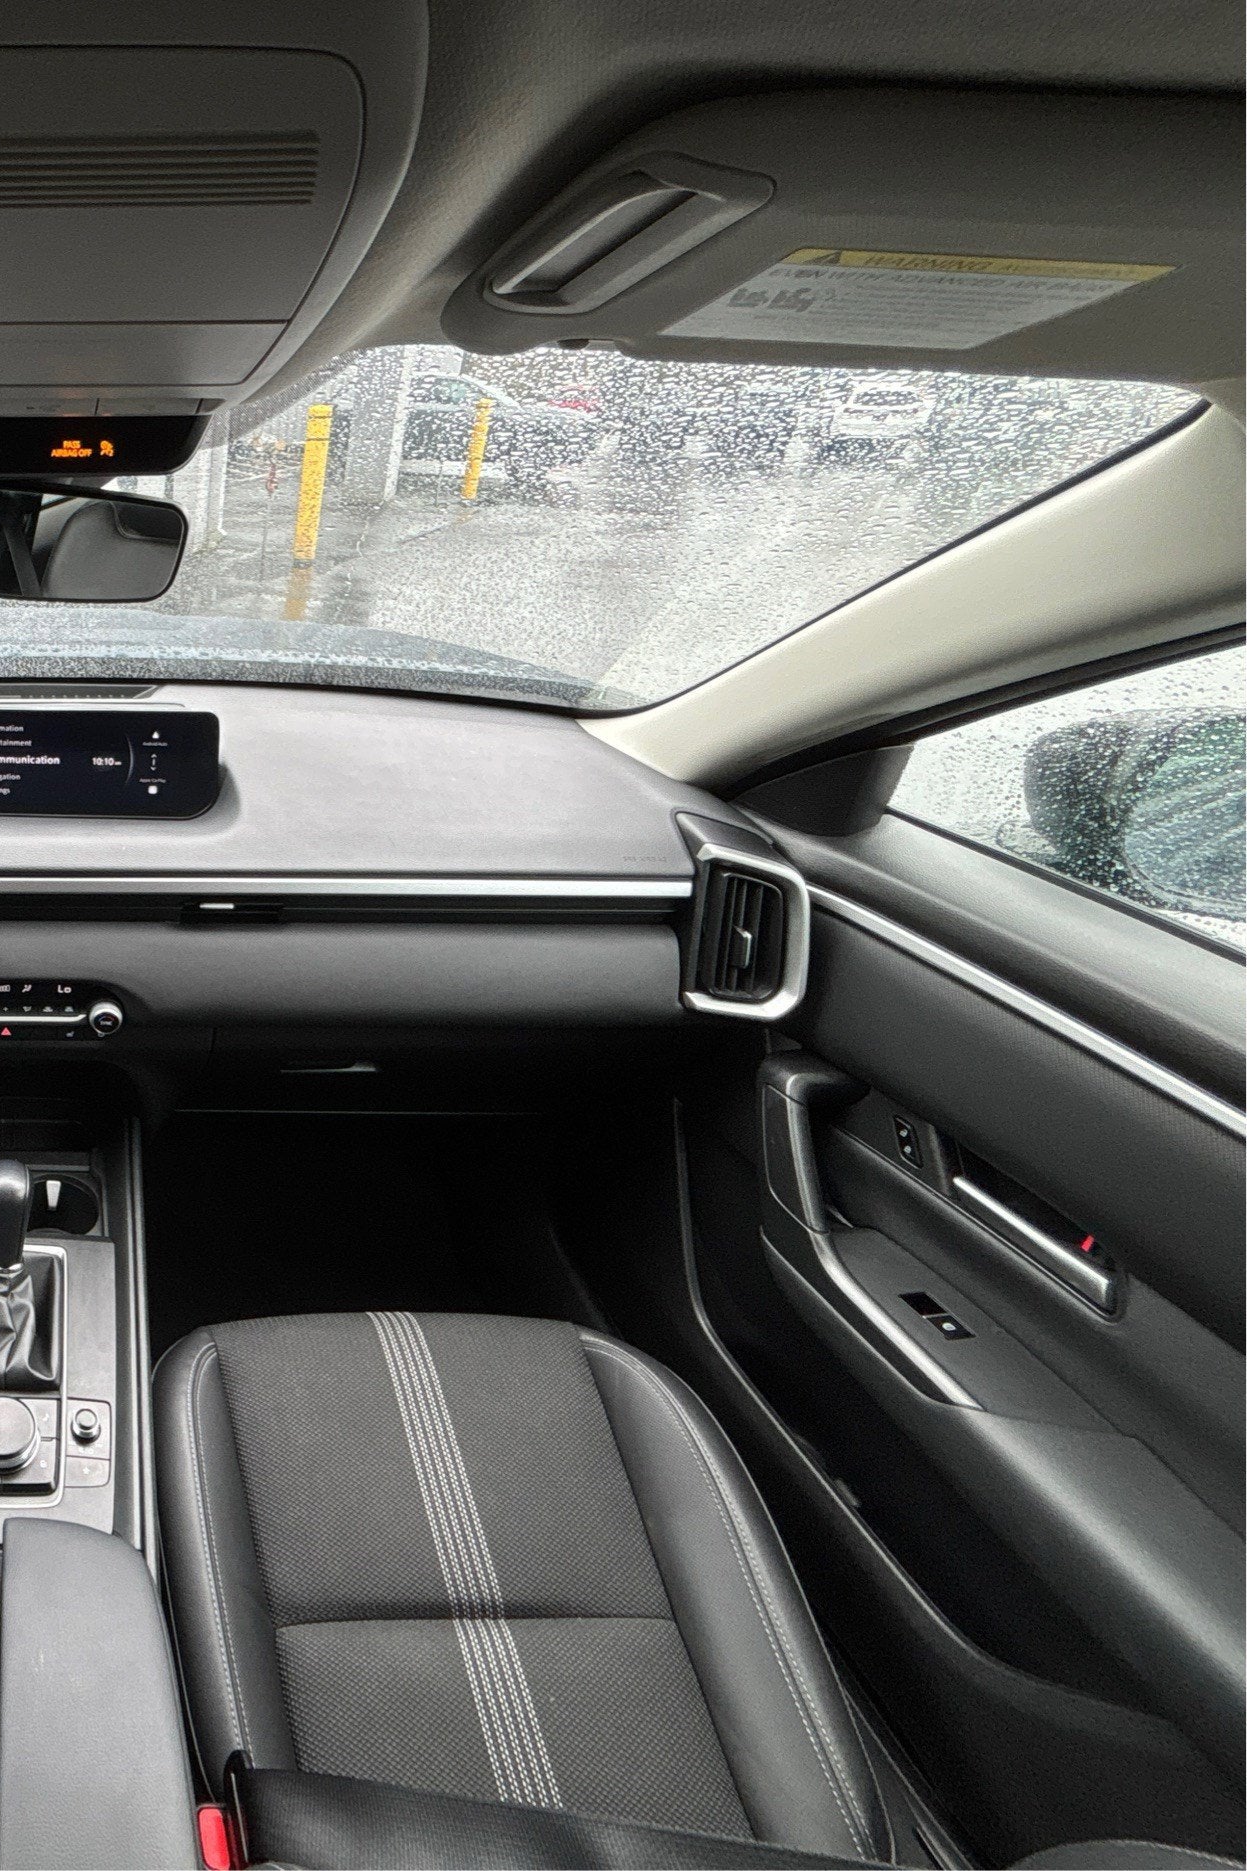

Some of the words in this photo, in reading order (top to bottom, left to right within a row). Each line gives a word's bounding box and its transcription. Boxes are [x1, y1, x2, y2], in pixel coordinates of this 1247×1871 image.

[63, 440, 81, 449] PASS
[51, 449, 77, 457] AIRBAG
[78, 449, 92, 457] OFF
[92, 757, 115, 766] 10:10
[57, 984, 72, 994] Lo
